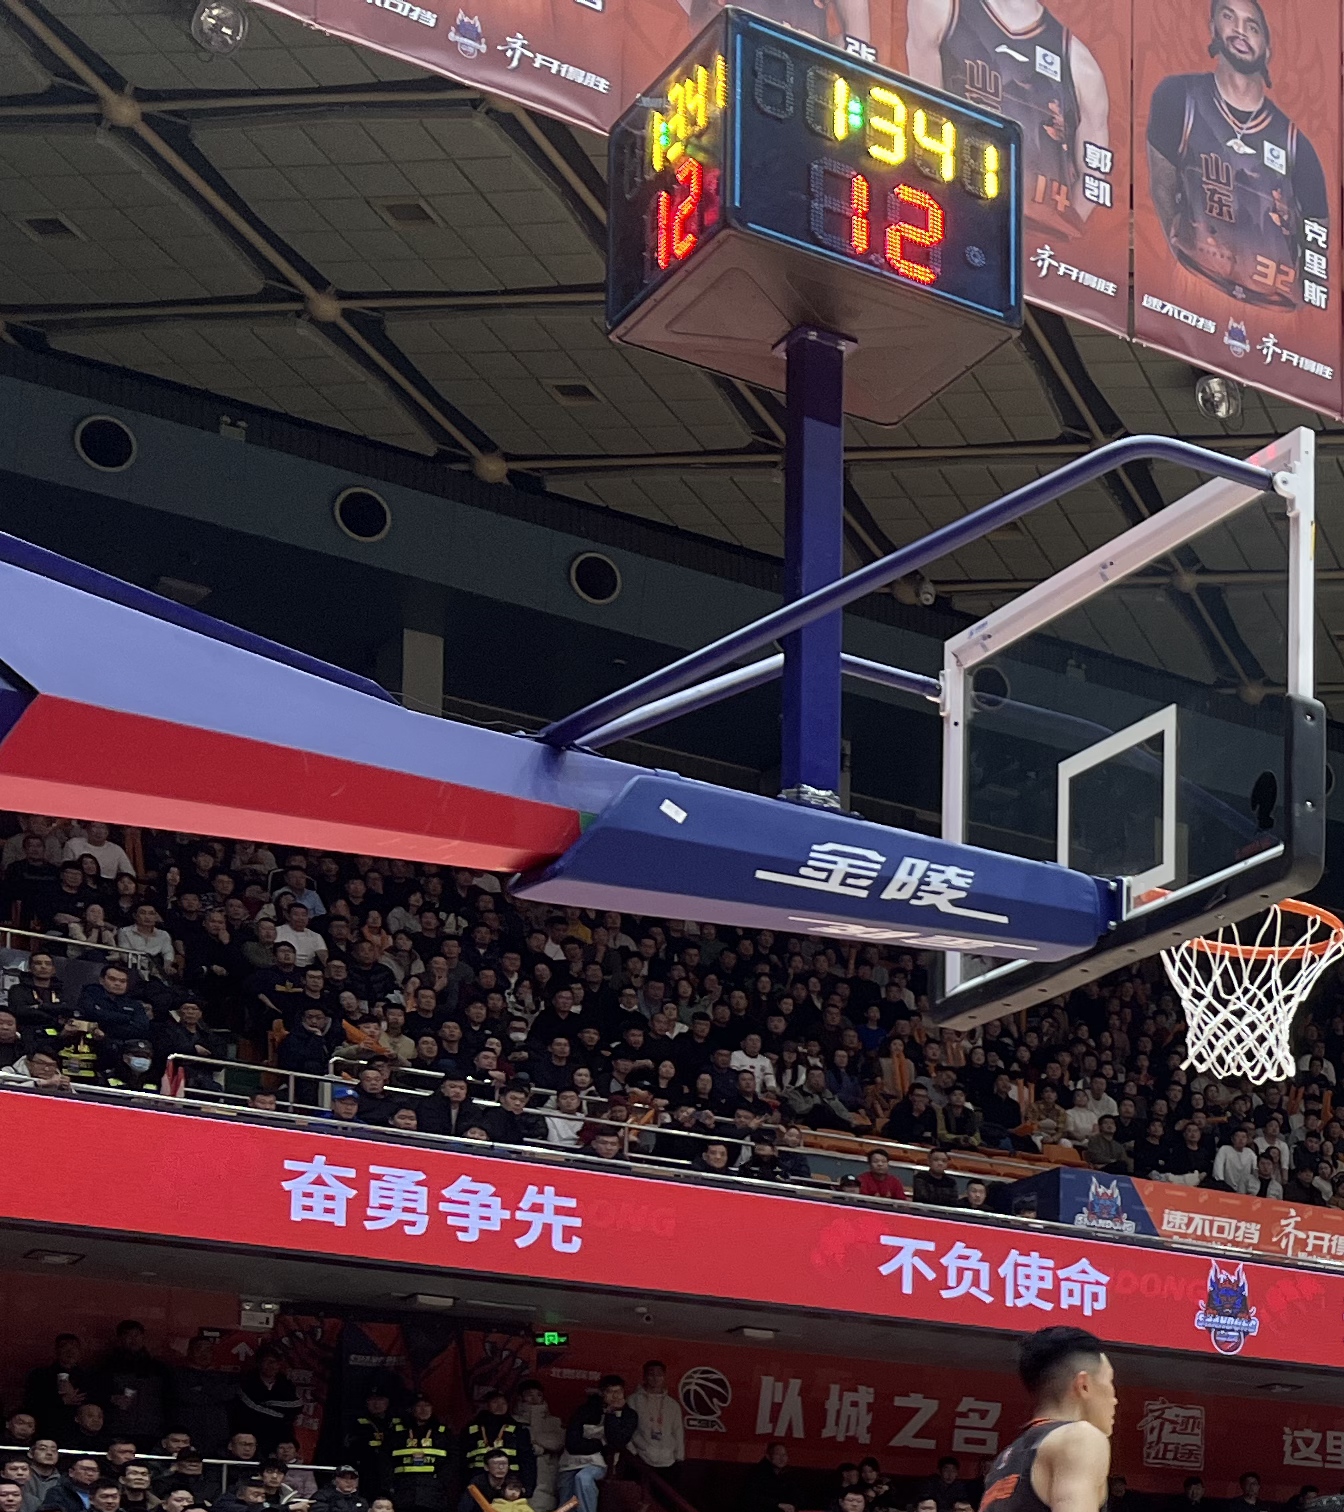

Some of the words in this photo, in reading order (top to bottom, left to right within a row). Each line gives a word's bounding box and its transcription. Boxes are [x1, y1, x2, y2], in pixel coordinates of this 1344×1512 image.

[1083, 141, 1114, 208] 郭凯
[851, 173, 946, 285] 12
[1302, 219, 1329, 310] 克里斯
[1252, 255, 1297, 293] 32
[772, 841, 1002, 924] 金陵
[280, 1155, 583, 1255] 奋勇争先
[1160, 1208, 1262, 1245] 速不可挡
[878, 1233, 1111, 1317] 不负使命
[754, 1374, 1003, 1455] 以城之名
